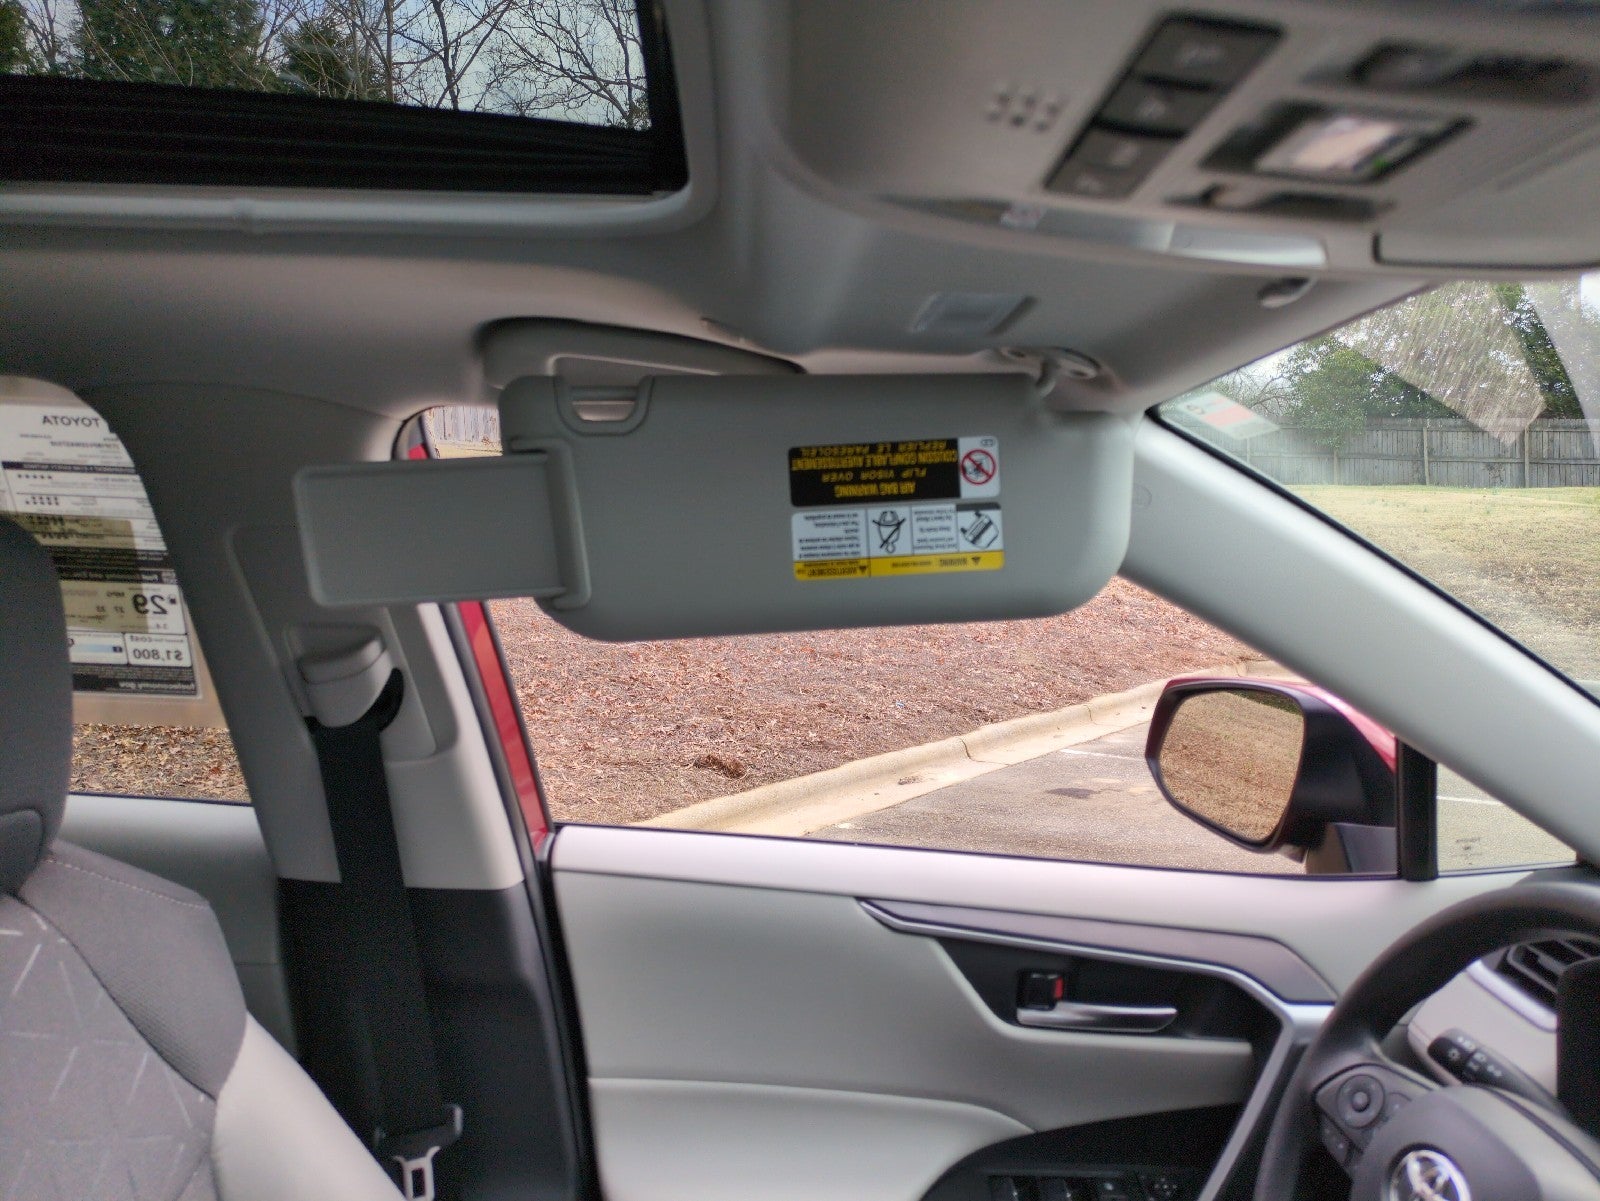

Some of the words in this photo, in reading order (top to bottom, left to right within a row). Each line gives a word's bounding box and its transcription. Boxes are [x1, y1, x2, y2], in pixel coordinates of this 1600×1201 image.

[821, 471, 854, 483] OVER
[860, 469, 895, 480] VISOR
[901, 467, 927, 478] FLIP
[834, 483, 878, 498] WARNING
[898, 481, 917, 495] AIR
